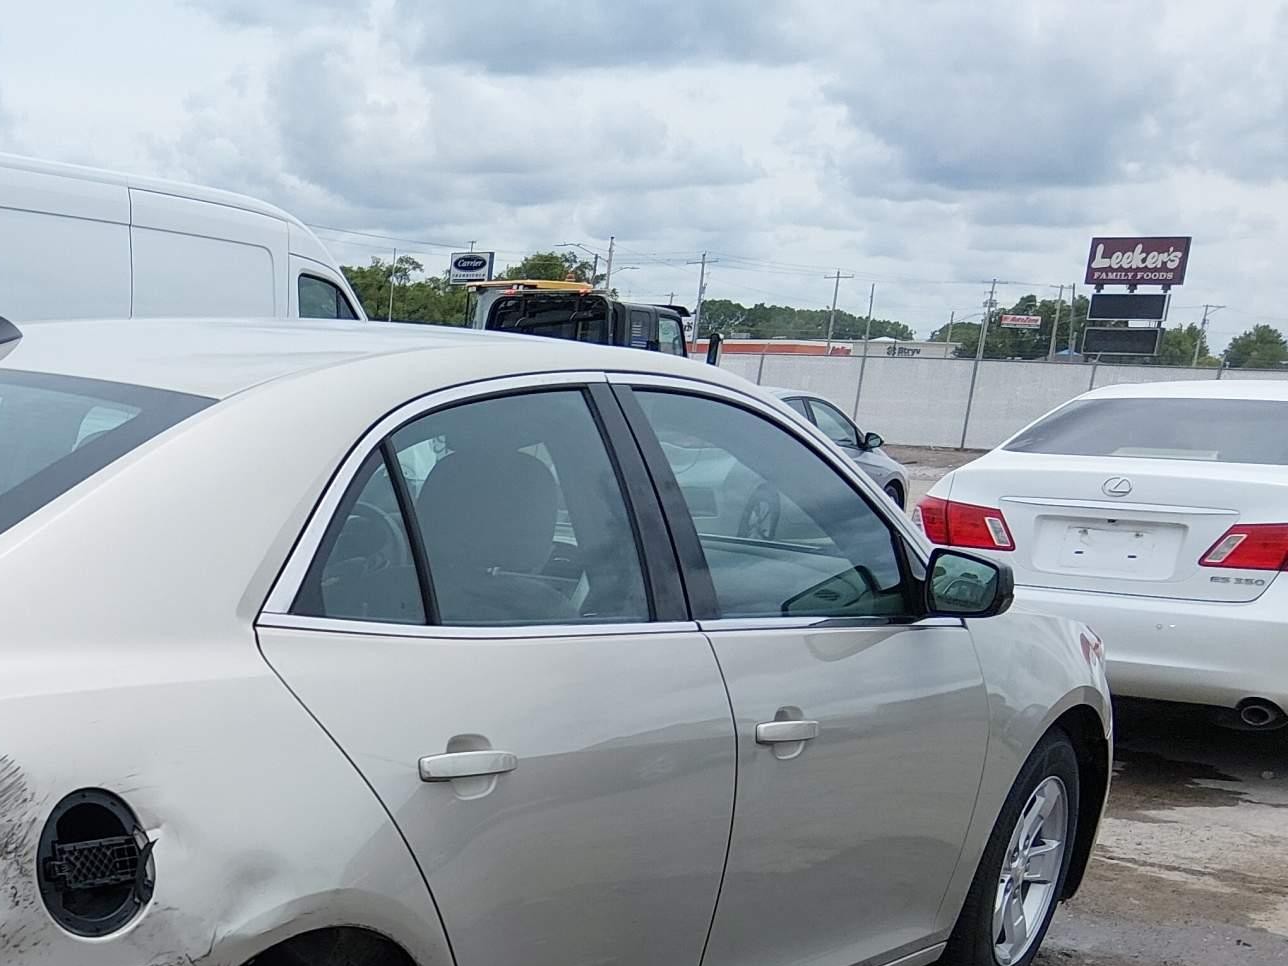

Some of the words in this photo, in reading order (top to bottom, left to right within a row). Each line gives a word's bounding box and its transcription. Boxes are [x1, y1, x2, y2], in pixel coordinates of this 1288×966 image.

[1091, 243, 1183, 269] Leeker's
[1093, 272, 1134, 280] FAMILY
[1135, 272, 1174, 280] FOODS
[1210, 576, 1230, 584] ES
[1232, 577, 1265, 586] 350
